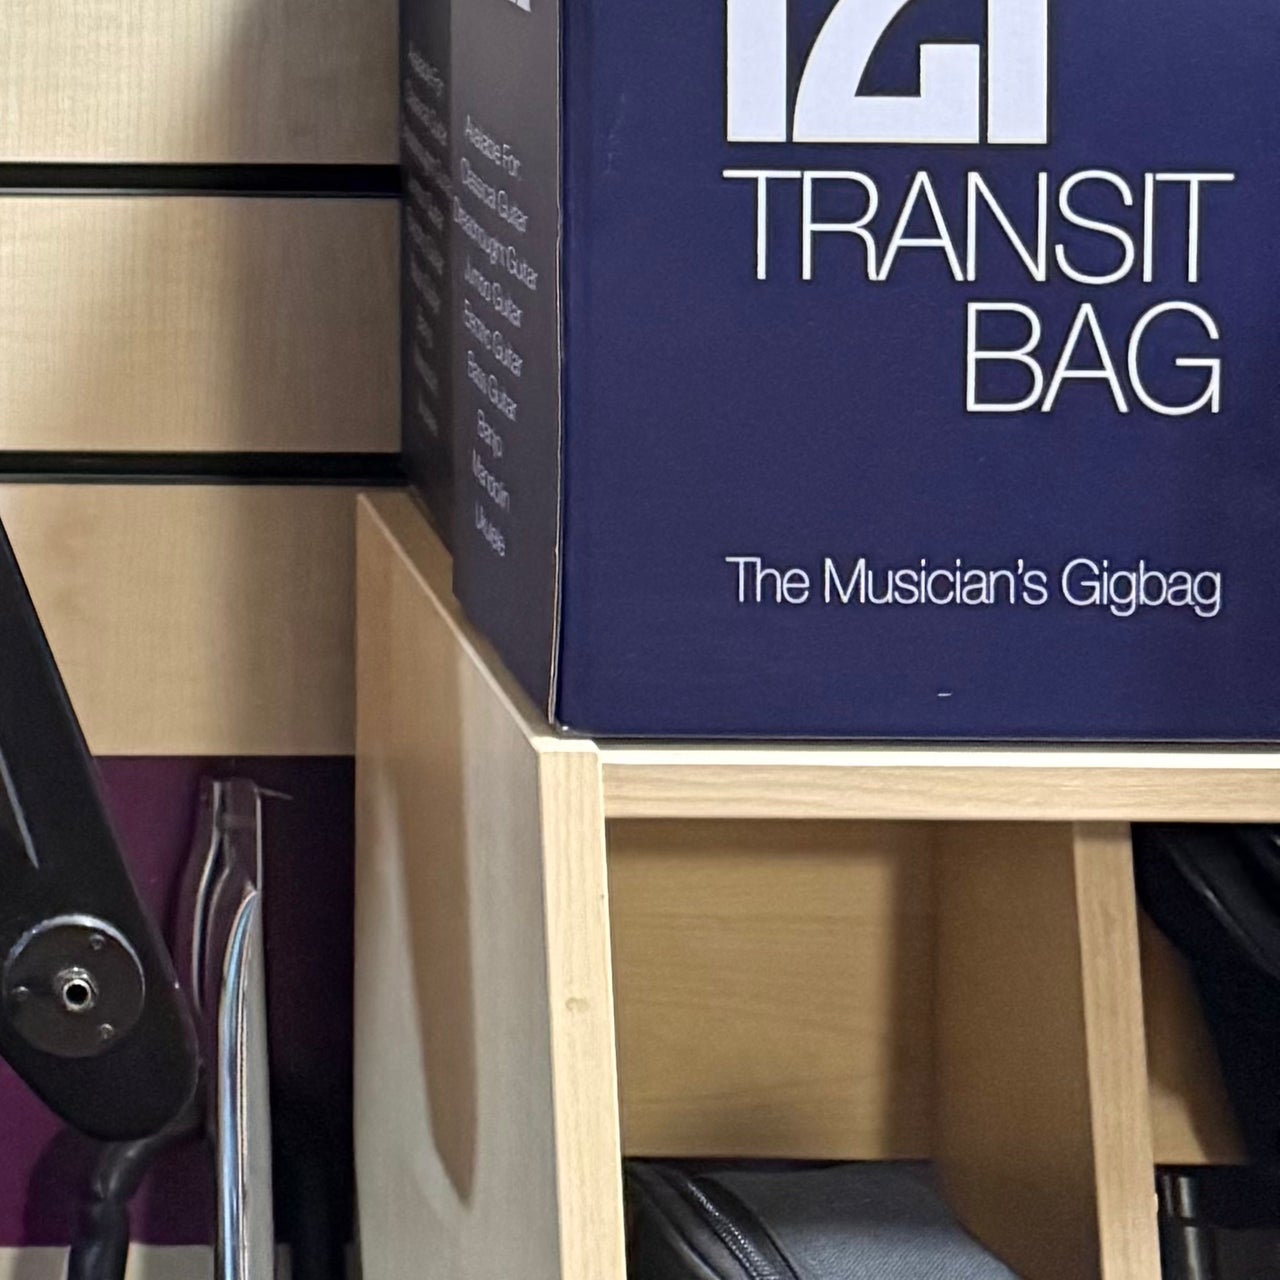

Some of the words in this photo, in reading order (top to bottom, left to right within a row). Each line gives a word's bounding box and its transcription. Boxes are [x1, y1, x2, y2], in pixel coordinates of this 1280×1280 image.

[723, 169, 1235, 285] TRANSIT
[966, 301, 1221, 416] BAG
[725, 556, 810, 604] The
[824, 557, 1048, 605] Musician's
[1060, 557, 1222, 618] Gigbag
